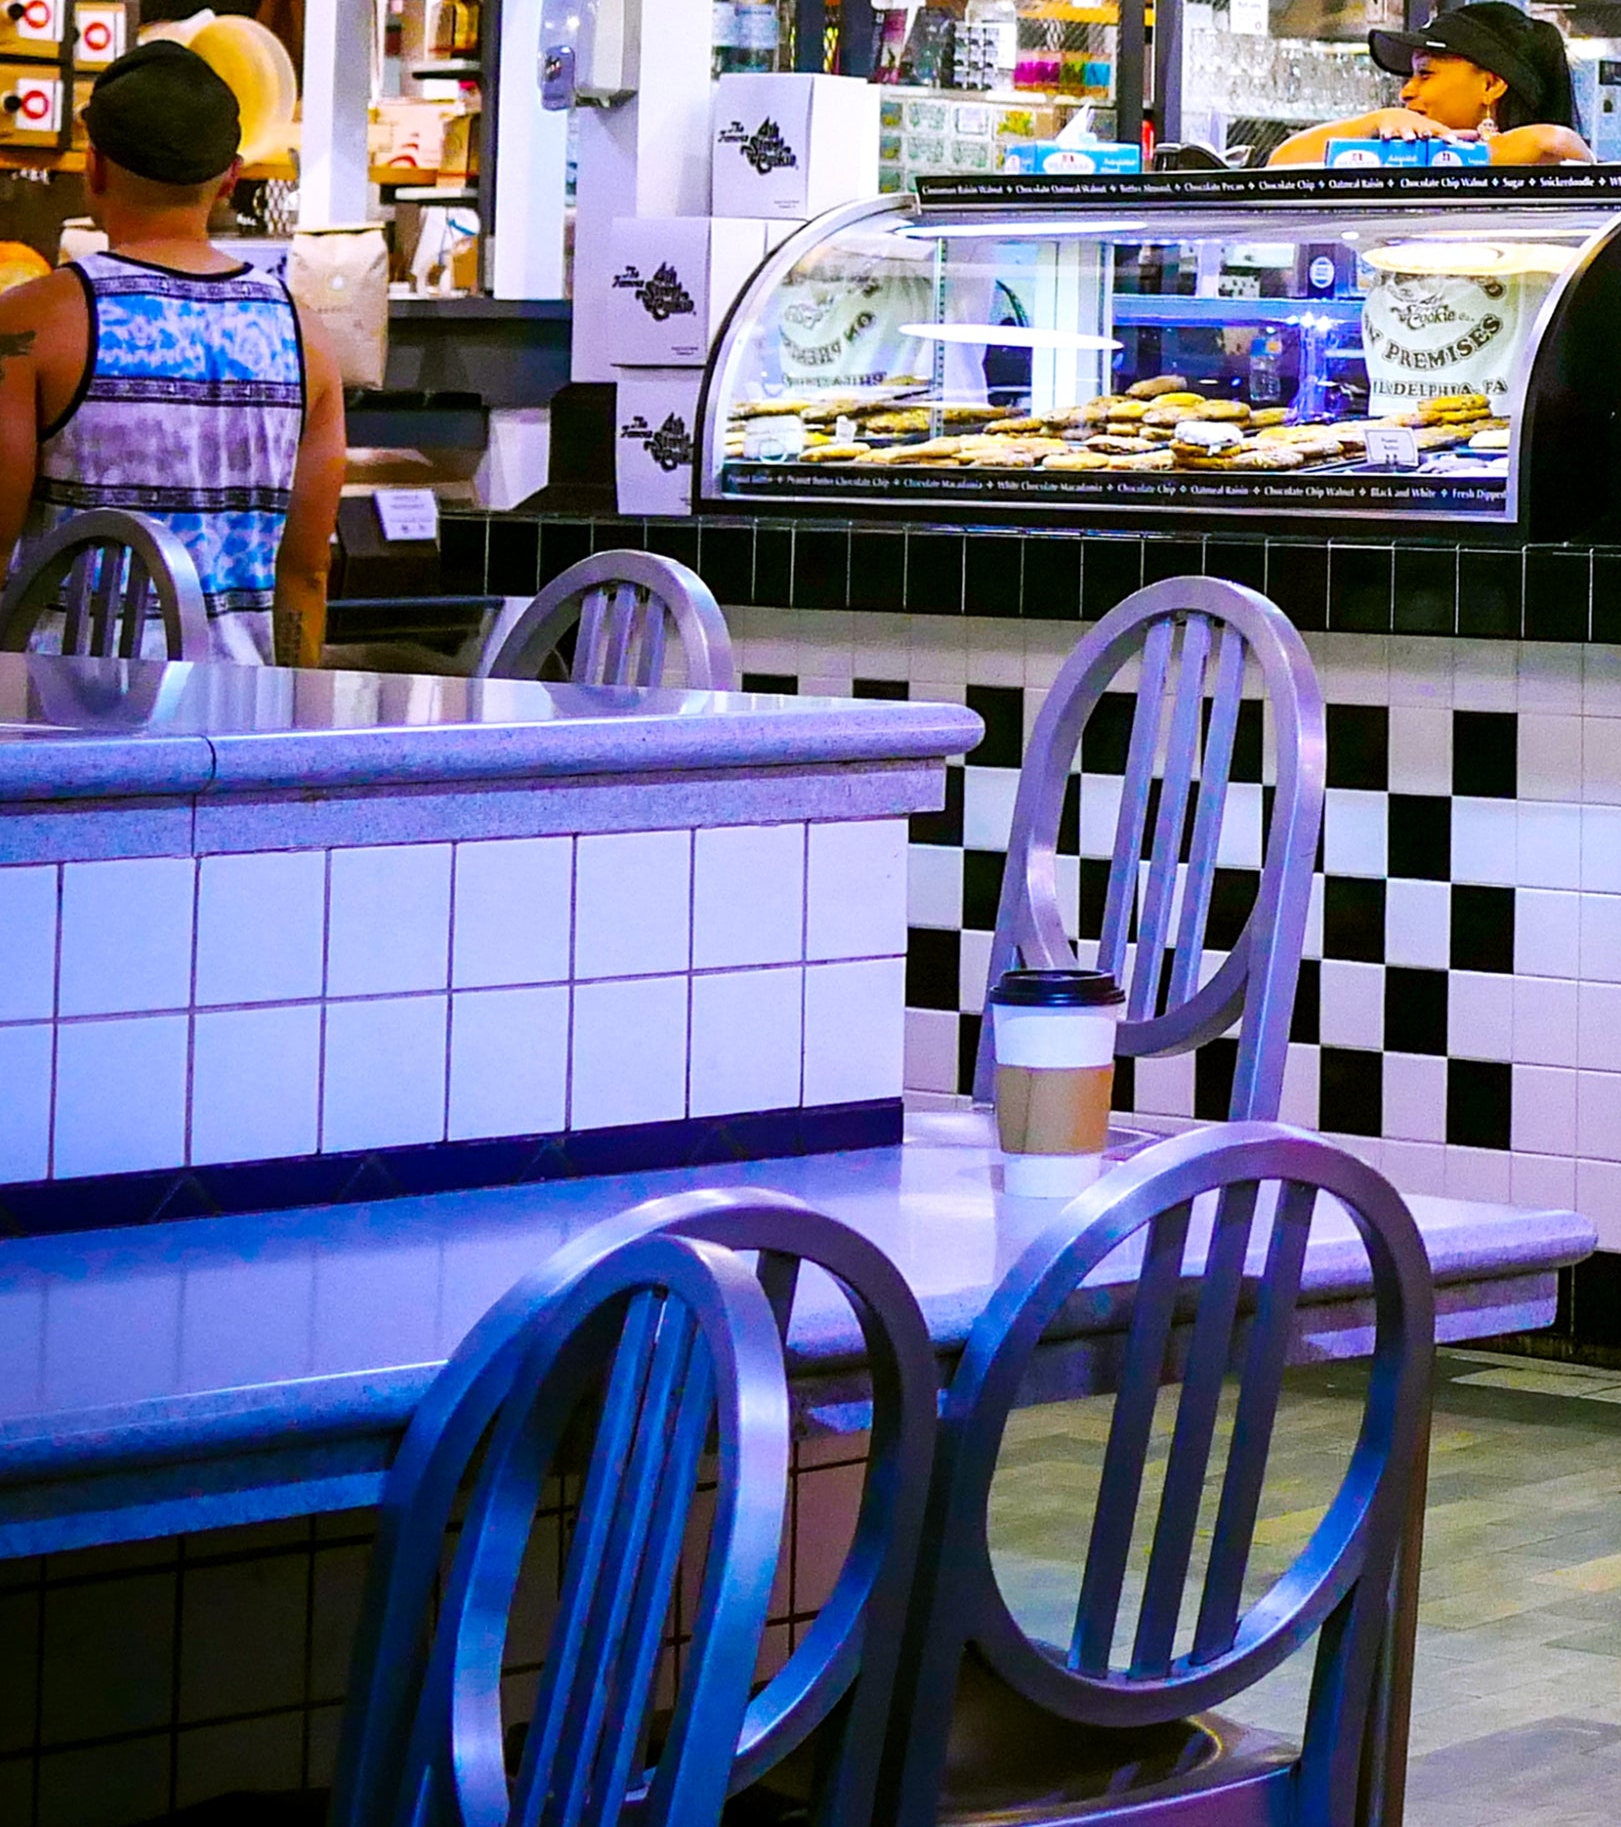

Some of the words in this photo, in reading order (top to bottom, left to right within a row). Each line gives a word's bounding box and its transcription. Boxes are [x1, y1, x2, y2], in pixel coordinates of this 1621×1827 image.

[1401, 177, 1440, 189] Chocolate
[1442, 177, 1460, 191] Chip
[1461, 177, 1489, 188] Walnut
[1502, 177, 1525, 190] Sugar
[1539, 176, 1595, 187] Snickerdoodle
[1385, 314, 1503, 369] PREMISES
[1371, 486, 1393, 498] Black
[1411, 487, 1435, 499] White
[1452, 487, 1475, 499] Fresh
